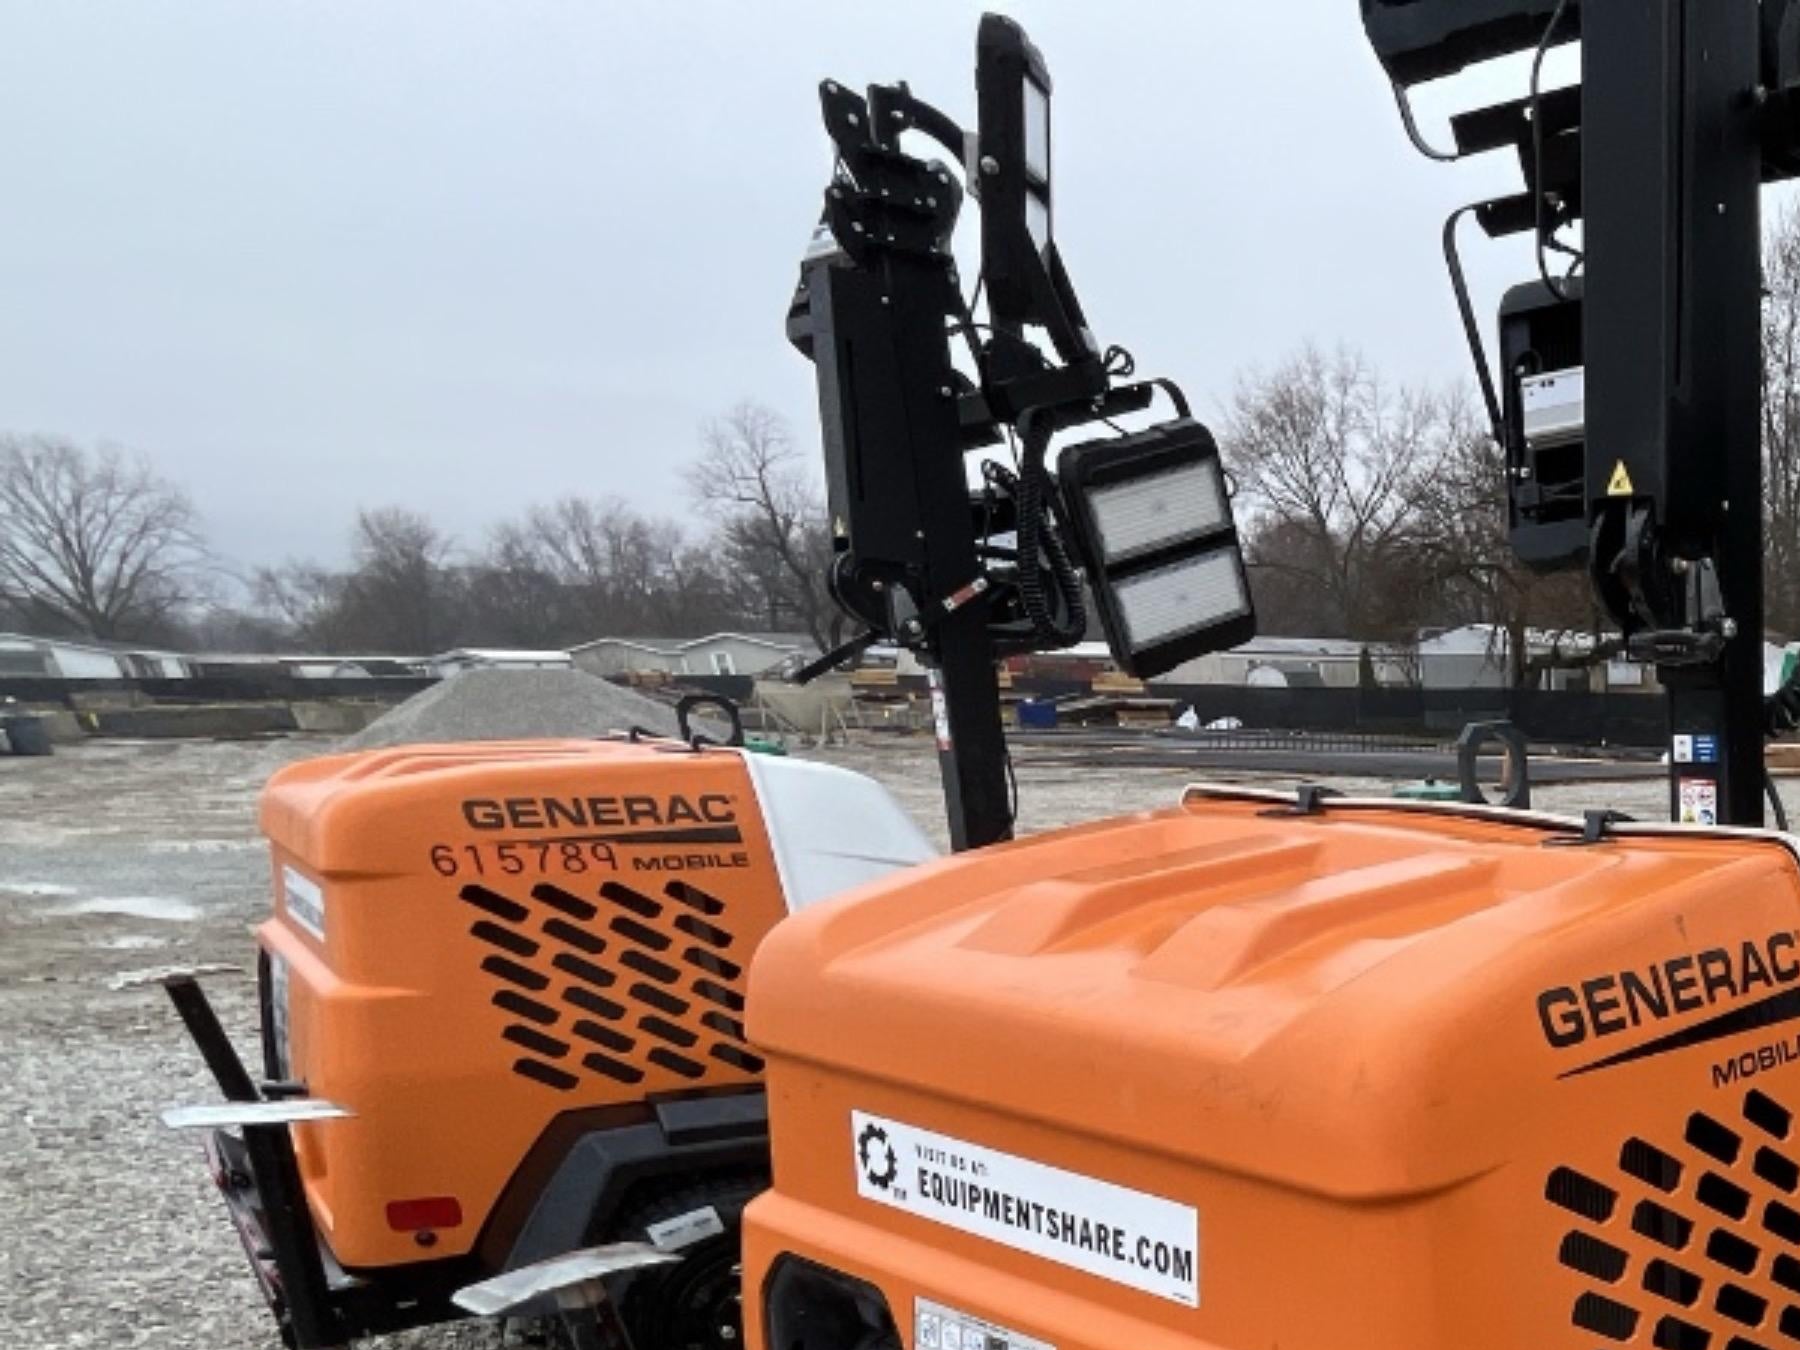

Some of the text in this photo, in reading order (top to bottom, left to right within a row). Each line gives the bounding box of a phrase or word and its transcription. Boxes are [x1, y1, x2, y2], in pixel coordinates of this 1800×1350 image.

[462, 794, 735, 829] GENERAC
[431, 842, 618, 877] 615789
[632, 852, 749, 871] MOBILE
[918, 1165, 1193, 1283] EQUIPMENTSHARE.COM
